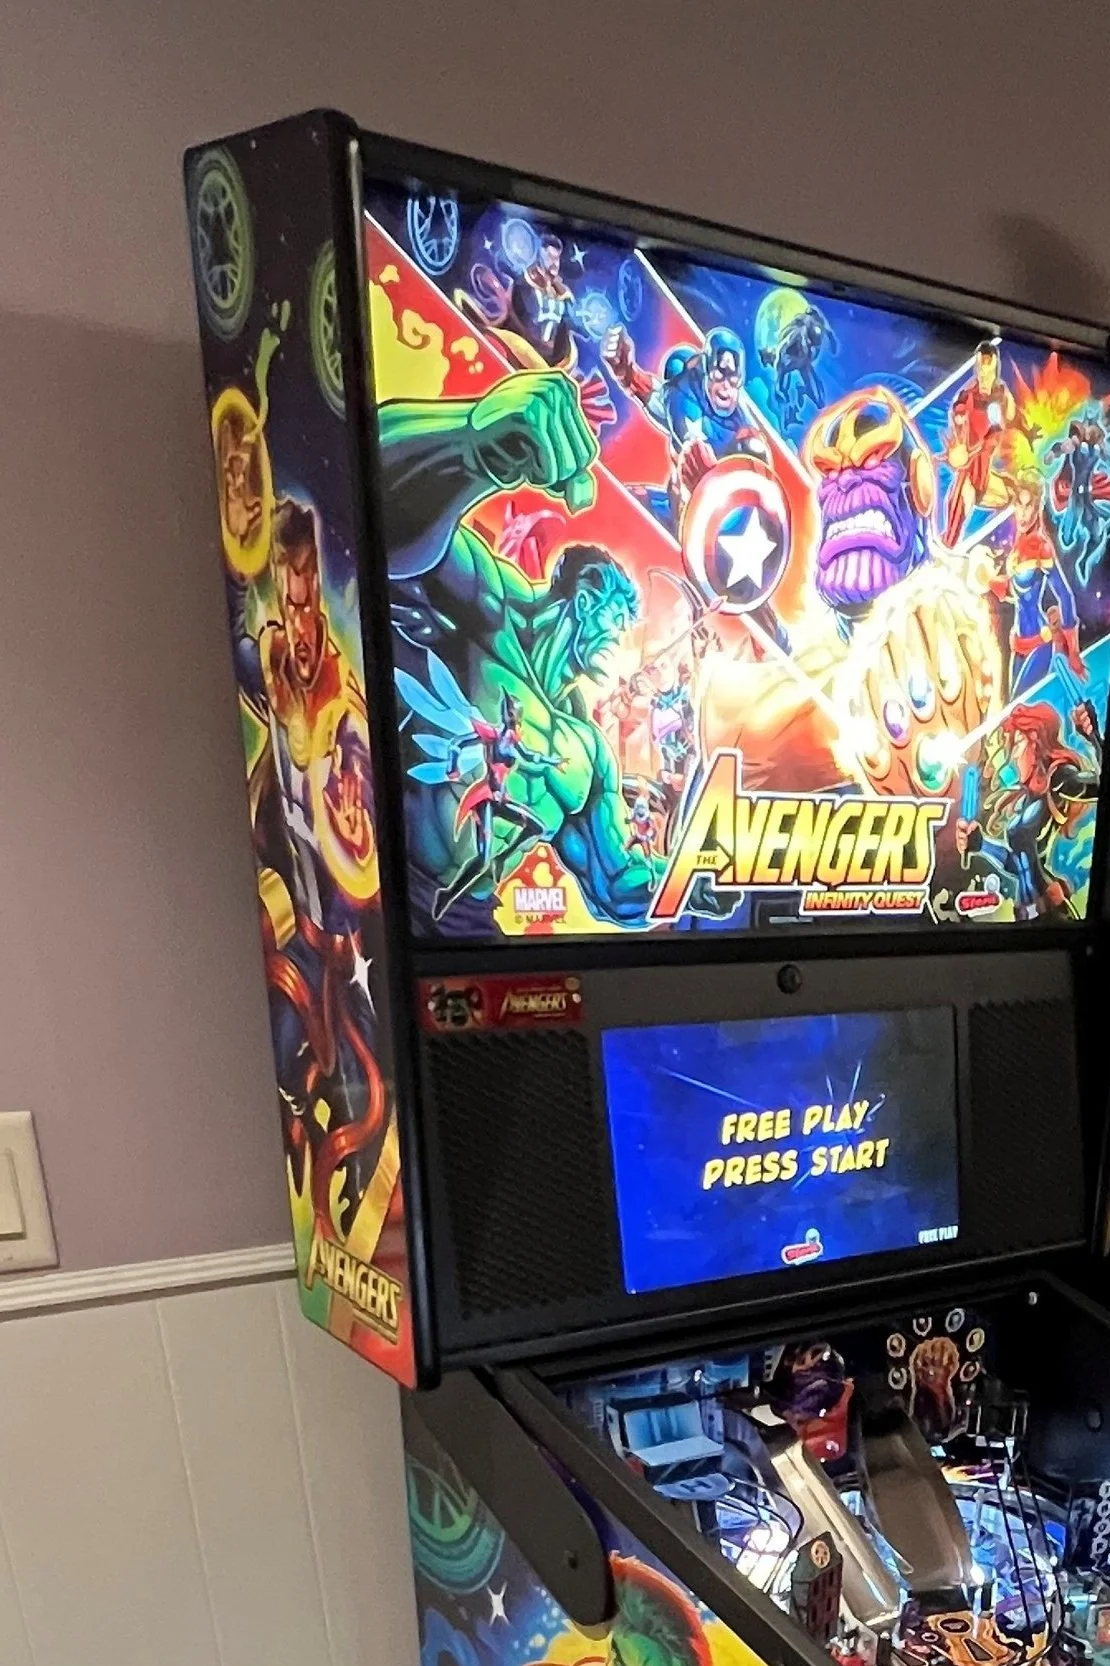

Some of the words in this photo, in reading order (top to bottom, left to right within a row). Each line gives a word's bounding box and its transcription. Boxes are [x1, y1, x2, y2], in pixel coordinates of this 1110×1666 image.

[650, 752, 946, 919] AVENGERS
[515, 888, 564, 911] MARVEL
[803, 891, 873, 910] INFINITY
[872, 890, 925, 909] QUEST
[721, 1108, 791, 1146] FREE
[802, 1100, 869, 1136] PLAY
[702, 1149, 798, 1190] PRESS
[810, 1138, 889, 1176] START
[304, 1236, 402, 1331] AVENGERS
